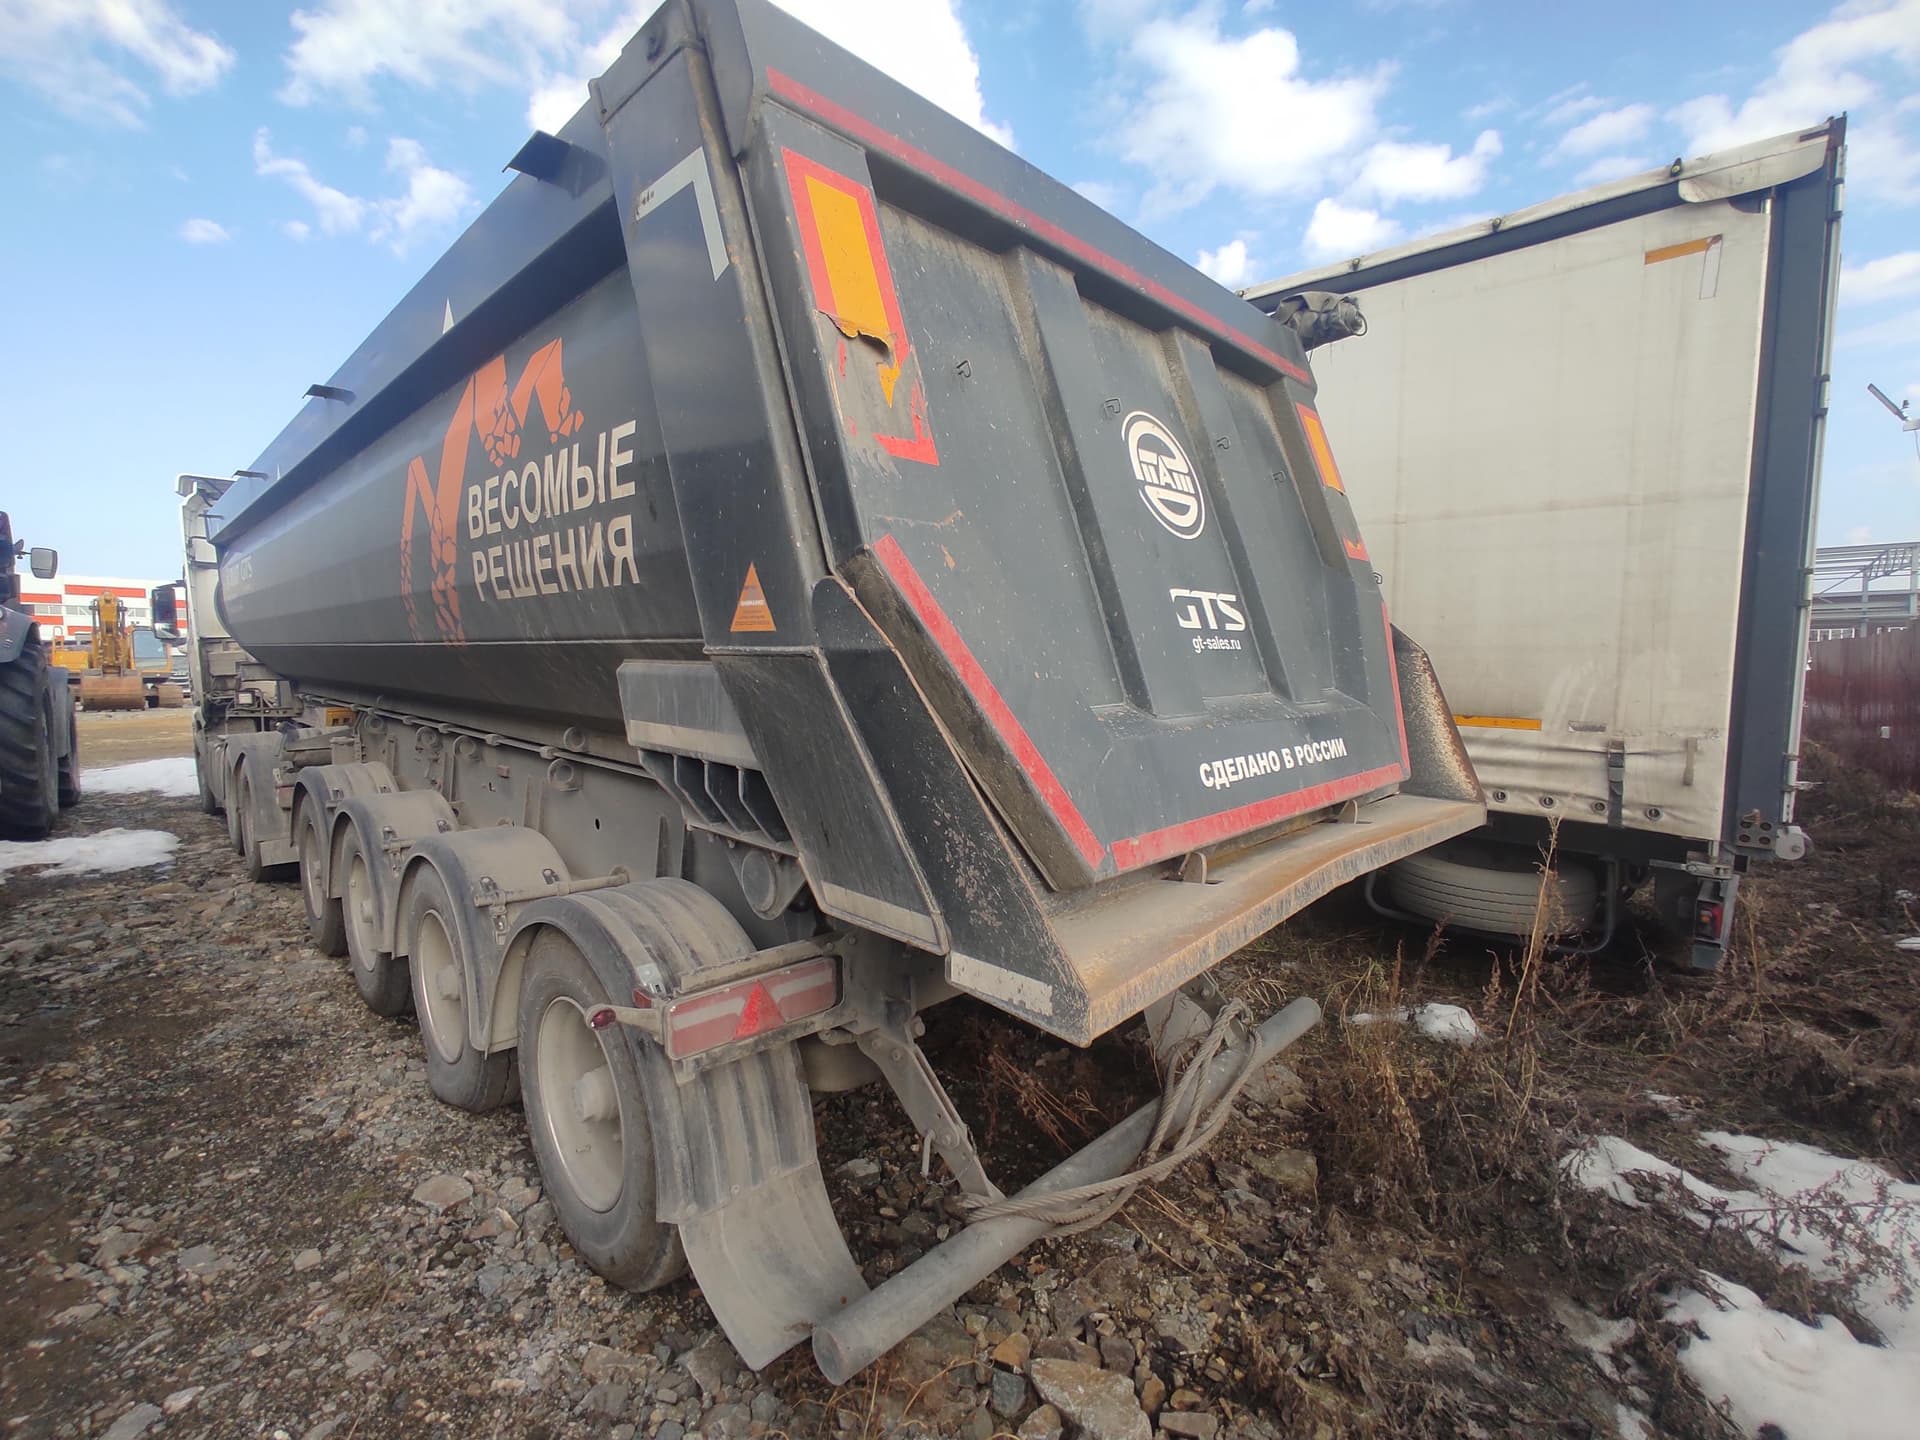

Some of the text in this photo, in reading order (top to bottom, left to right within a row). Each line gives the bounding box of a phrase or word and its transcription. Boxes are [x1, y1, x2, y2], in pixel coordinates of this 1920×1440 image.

[468, 420, 636, 539] ВЕСОМЫЕ
[472, 514, 640, 601] РЕШЕНИЯ
[1169, 588, 1246, 631] GTS
[1192, 635, 1242, 654] gt-sales.ru
[1199, 737, 1348, 790] СДЕЛАНО В РОССИИ
